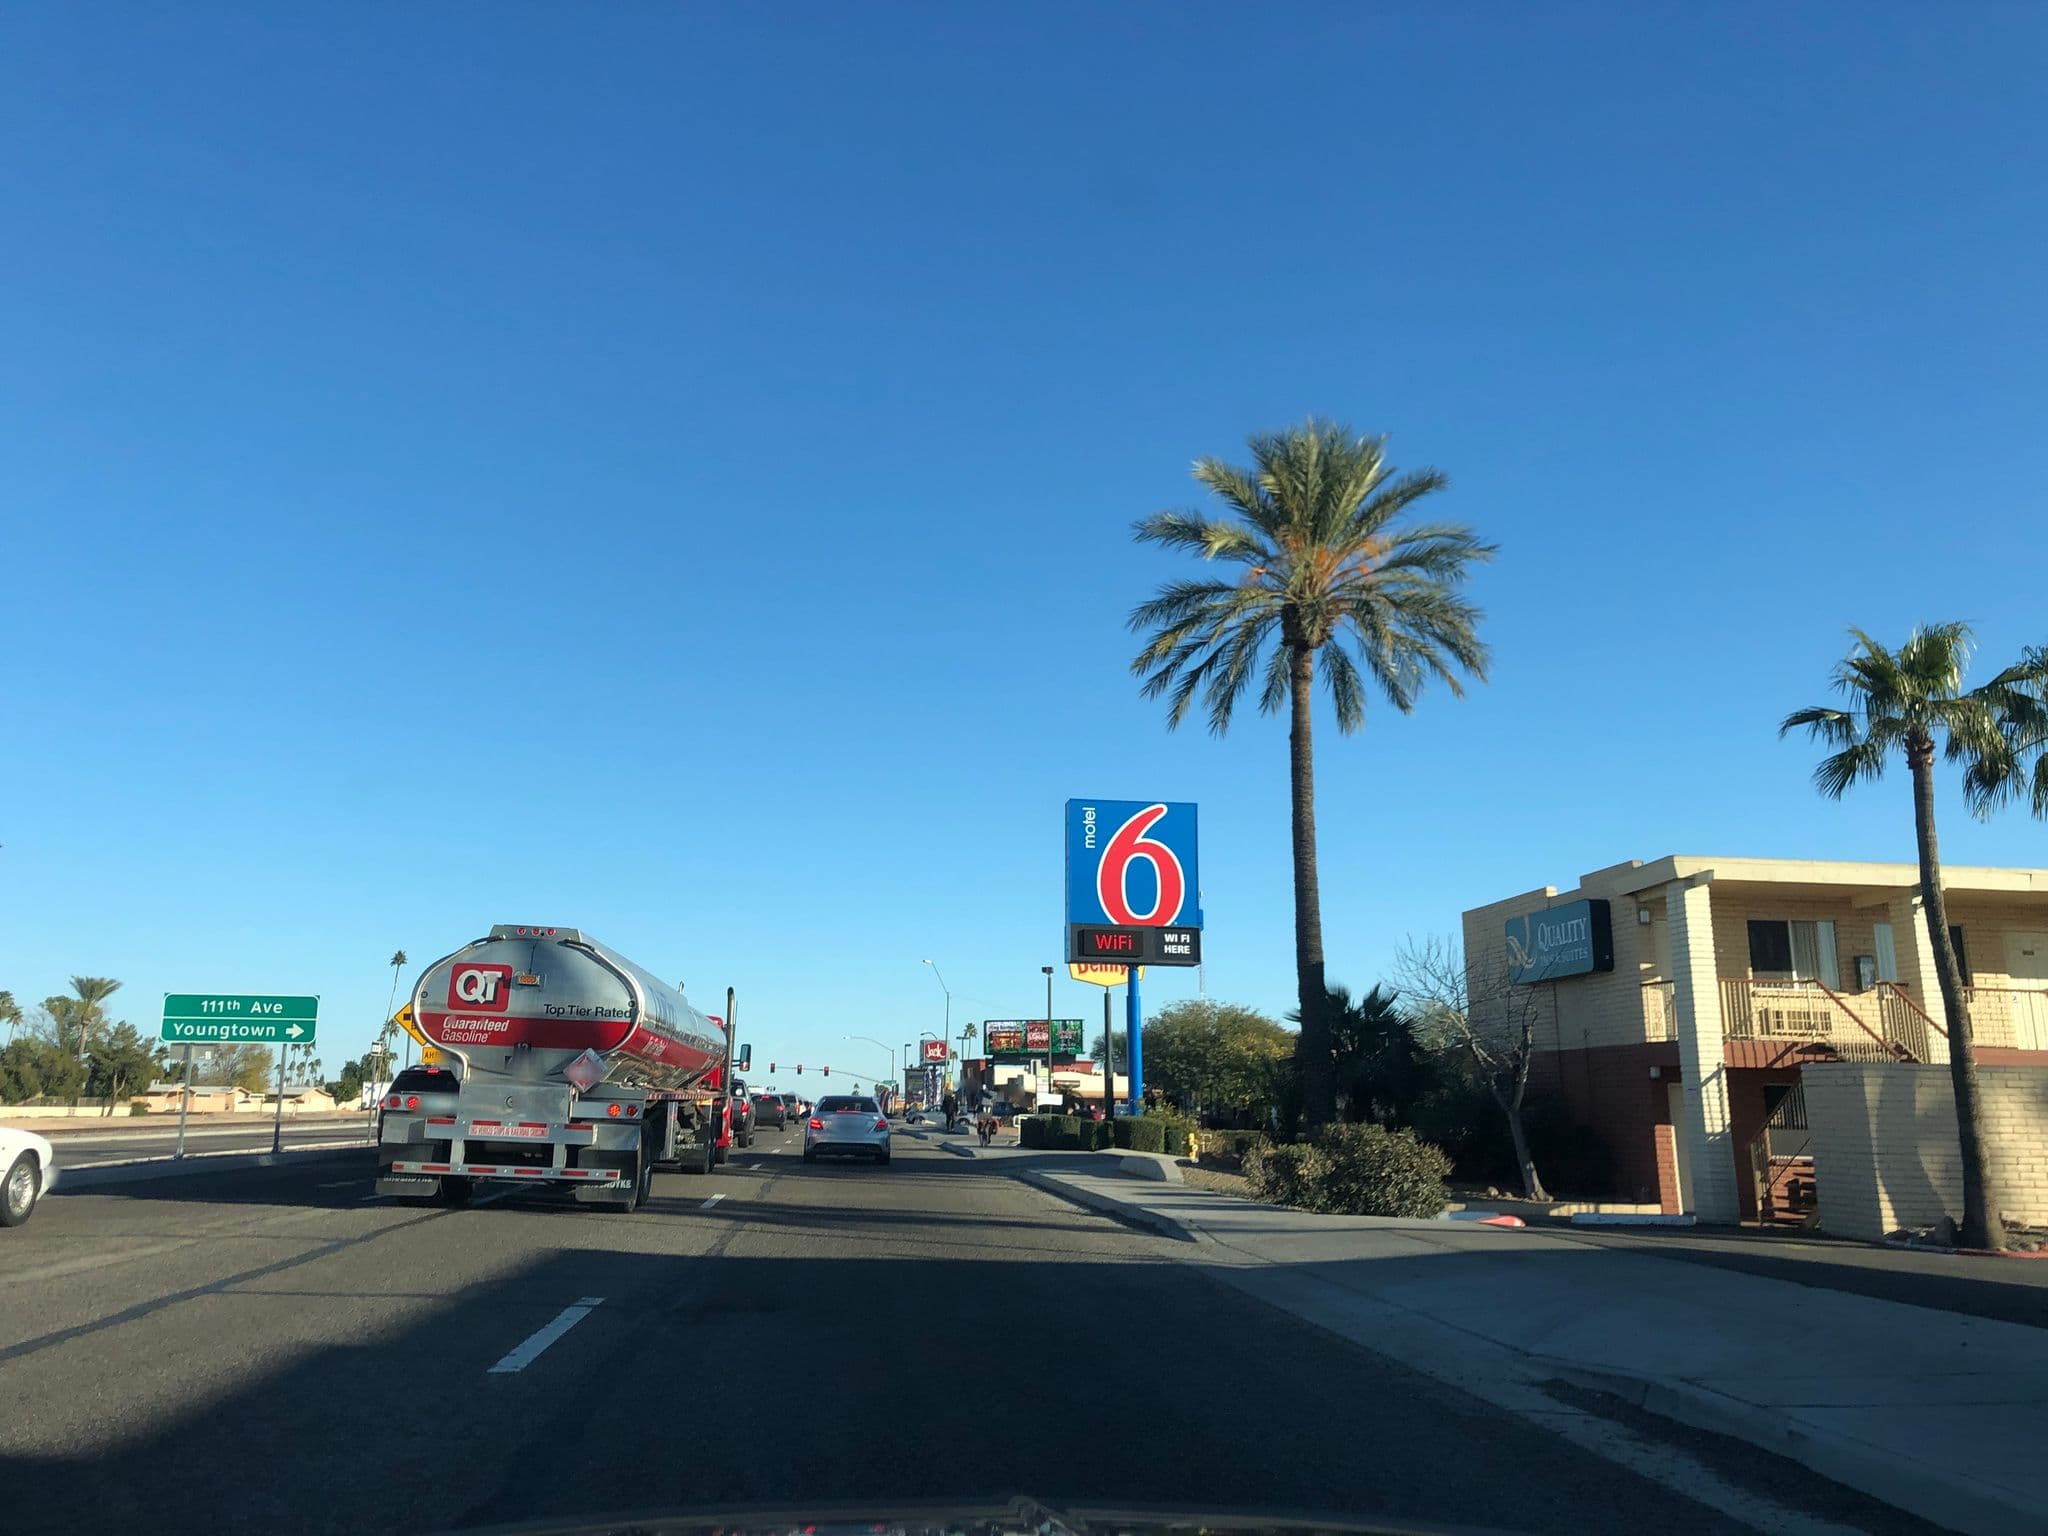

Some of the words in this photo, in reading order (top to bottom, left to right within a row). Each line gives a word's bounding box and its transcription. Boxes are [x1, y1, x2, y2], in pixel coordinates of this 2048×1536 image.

[1082, 807, 1096, 849] motel
[1097, 803, 1185, 926] 6
[1095, 934, 1133, 950] WiFi
[1164, 933, 1179, 943] WI
[1180, 934, 1190, 943] FI
[1538, 918, 1587, 951] QUALITY
[1164, 945, 1191, 954] HERE
[1078, 963, 1128, 975] Denny
[455, 969, 502, 1004] QT
[201, 1000, 240, 1013] 111th
[250, 1001, 283, 1014] Ave
[544, 1004, 566, 1017] Top
[568, 1005, 592, 1017] Tier
[595, 1006, 632, 1018] Rated
[174, 1023, 276, 1039] Youngtown
[443, 1016, 510, 1032] Guaranteed
[441, 1030, 488, 1043] Gasoline
[926, 1043, 946, 1058] Jack
